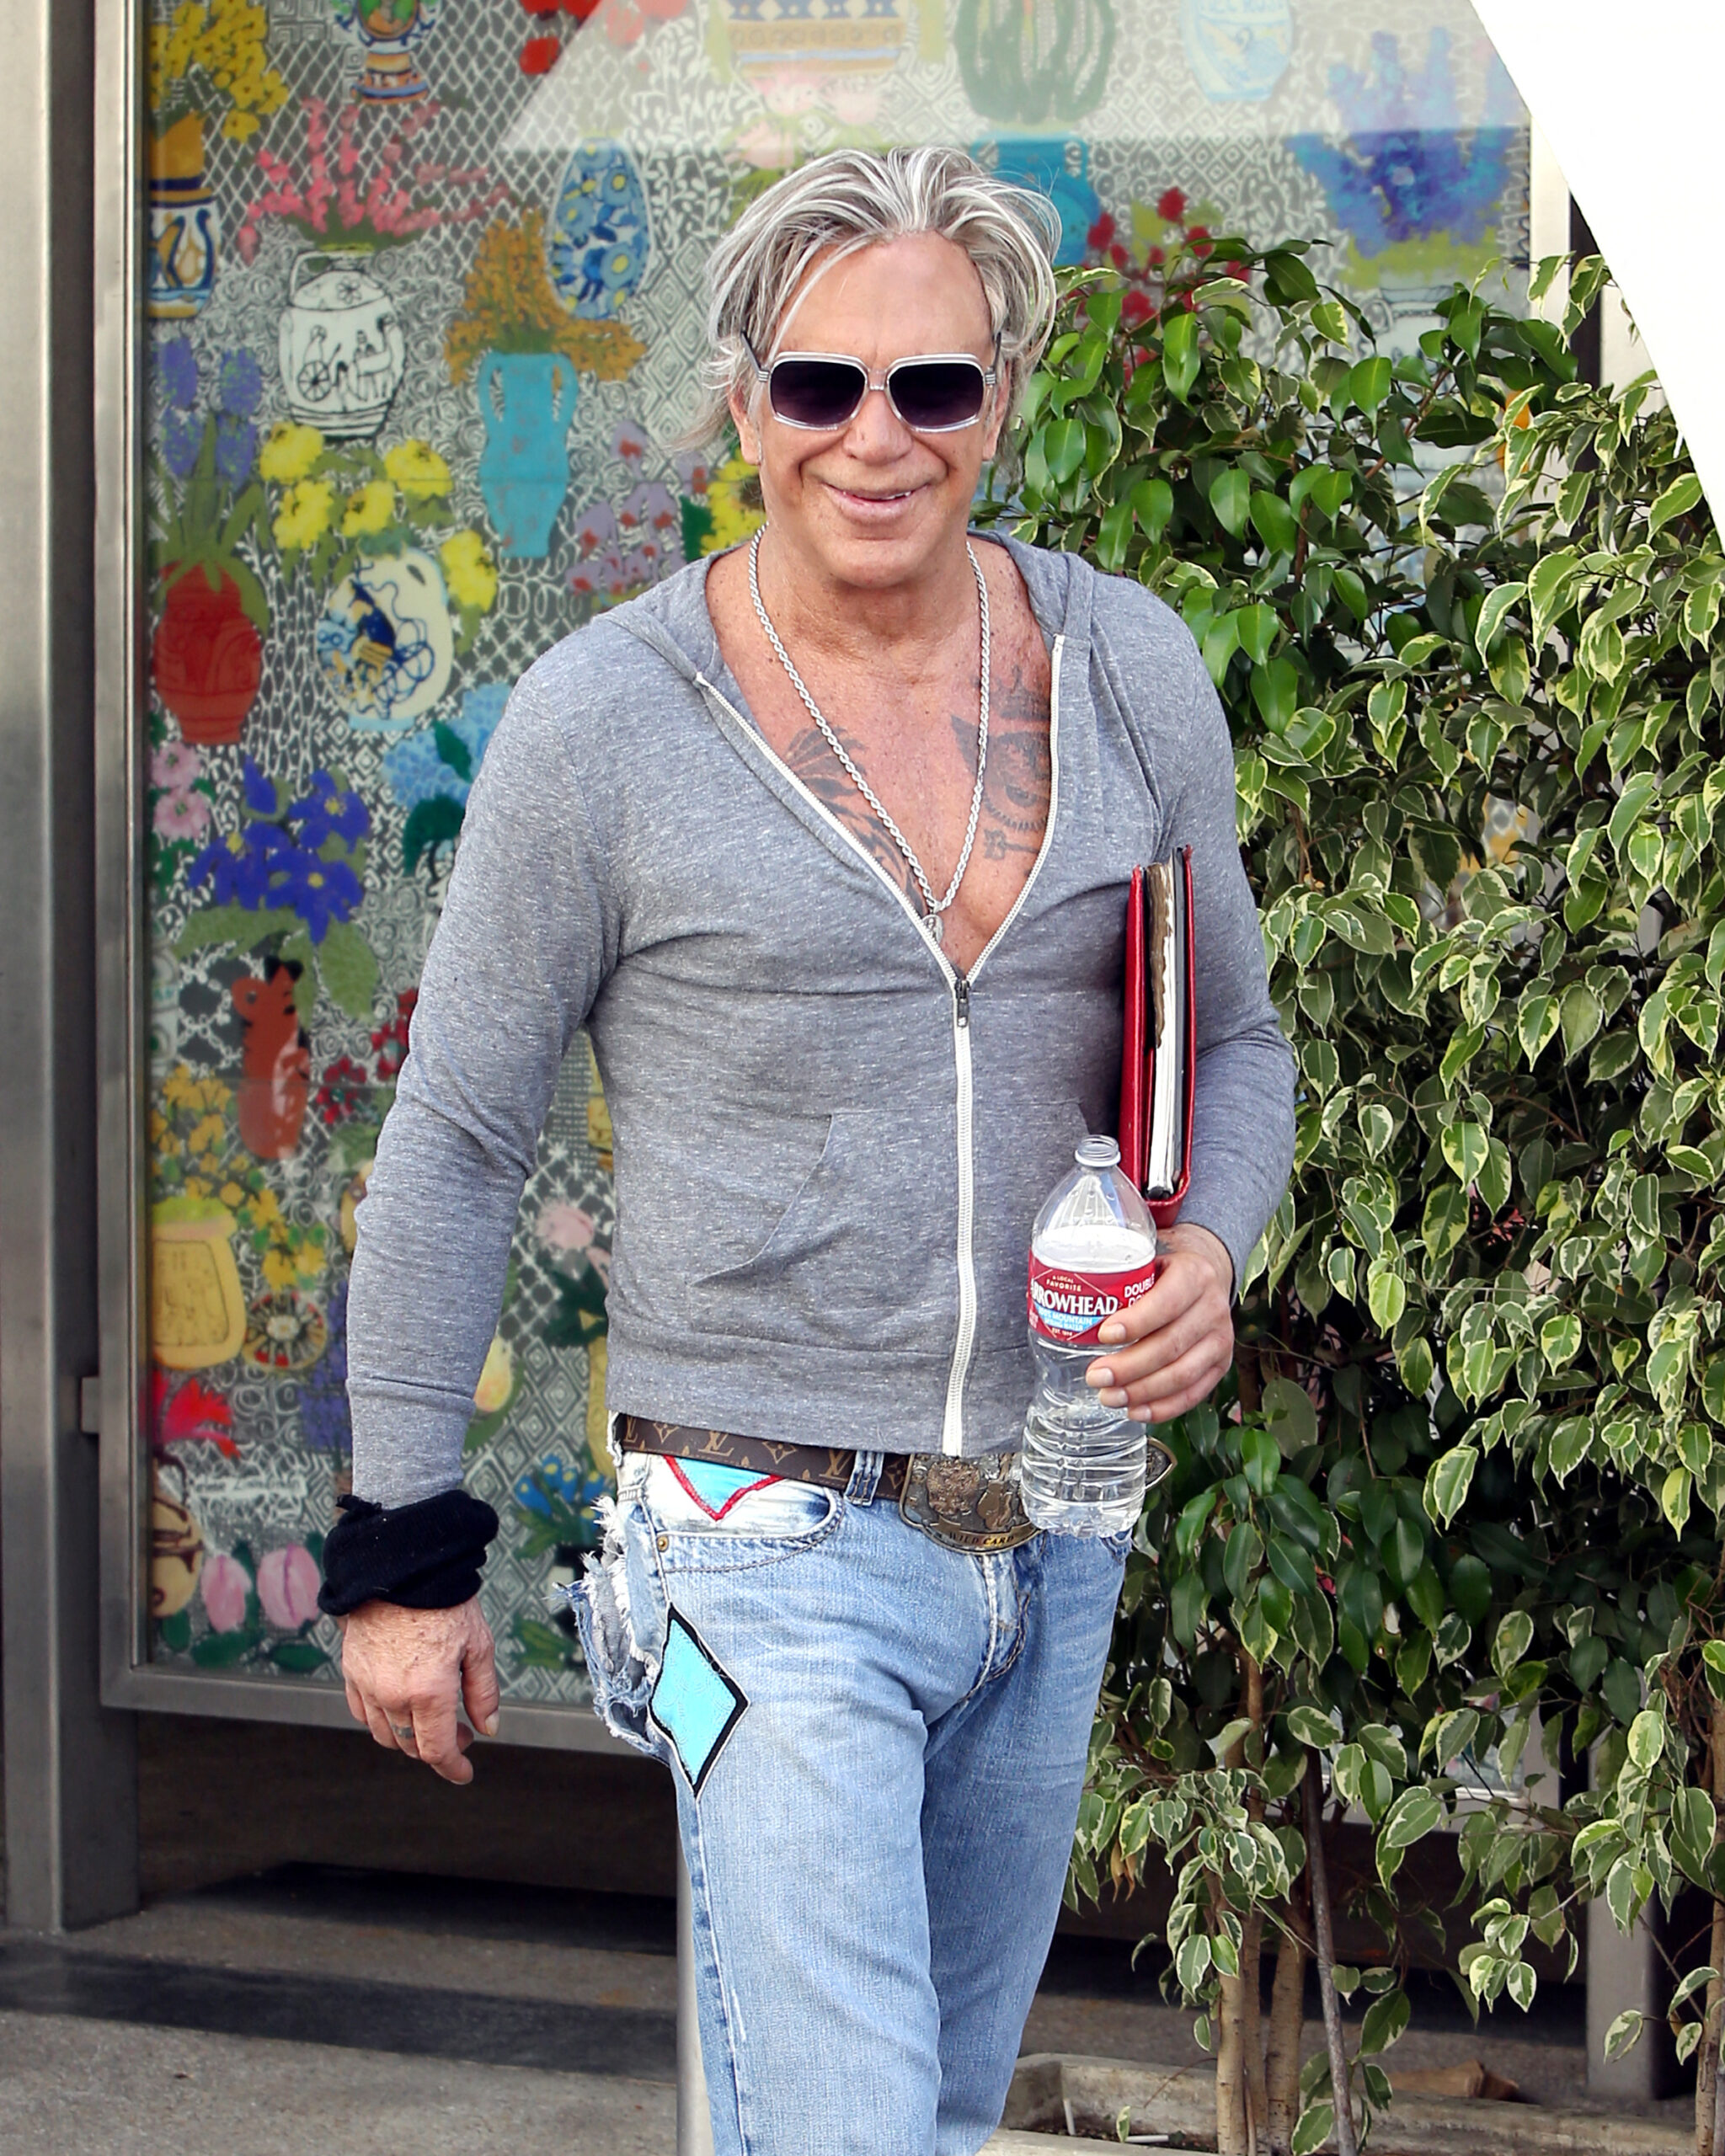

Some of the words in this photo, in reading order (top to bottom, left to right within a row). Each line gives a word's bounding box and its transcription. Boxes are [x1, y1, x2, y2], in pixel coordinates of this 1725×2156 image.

[1046, 1278, 1082, 1292] FAVORITE
[1030, 1278, 1118, 1315] ARROWHEAD
[1052, 1311, 1092, 1326] MOUNTAIN
[1064, 1321, 1084, 1331] WATER
[949, 1532, 980, 1544] WILD
[983, 1535, 1014, 1545] CARD
